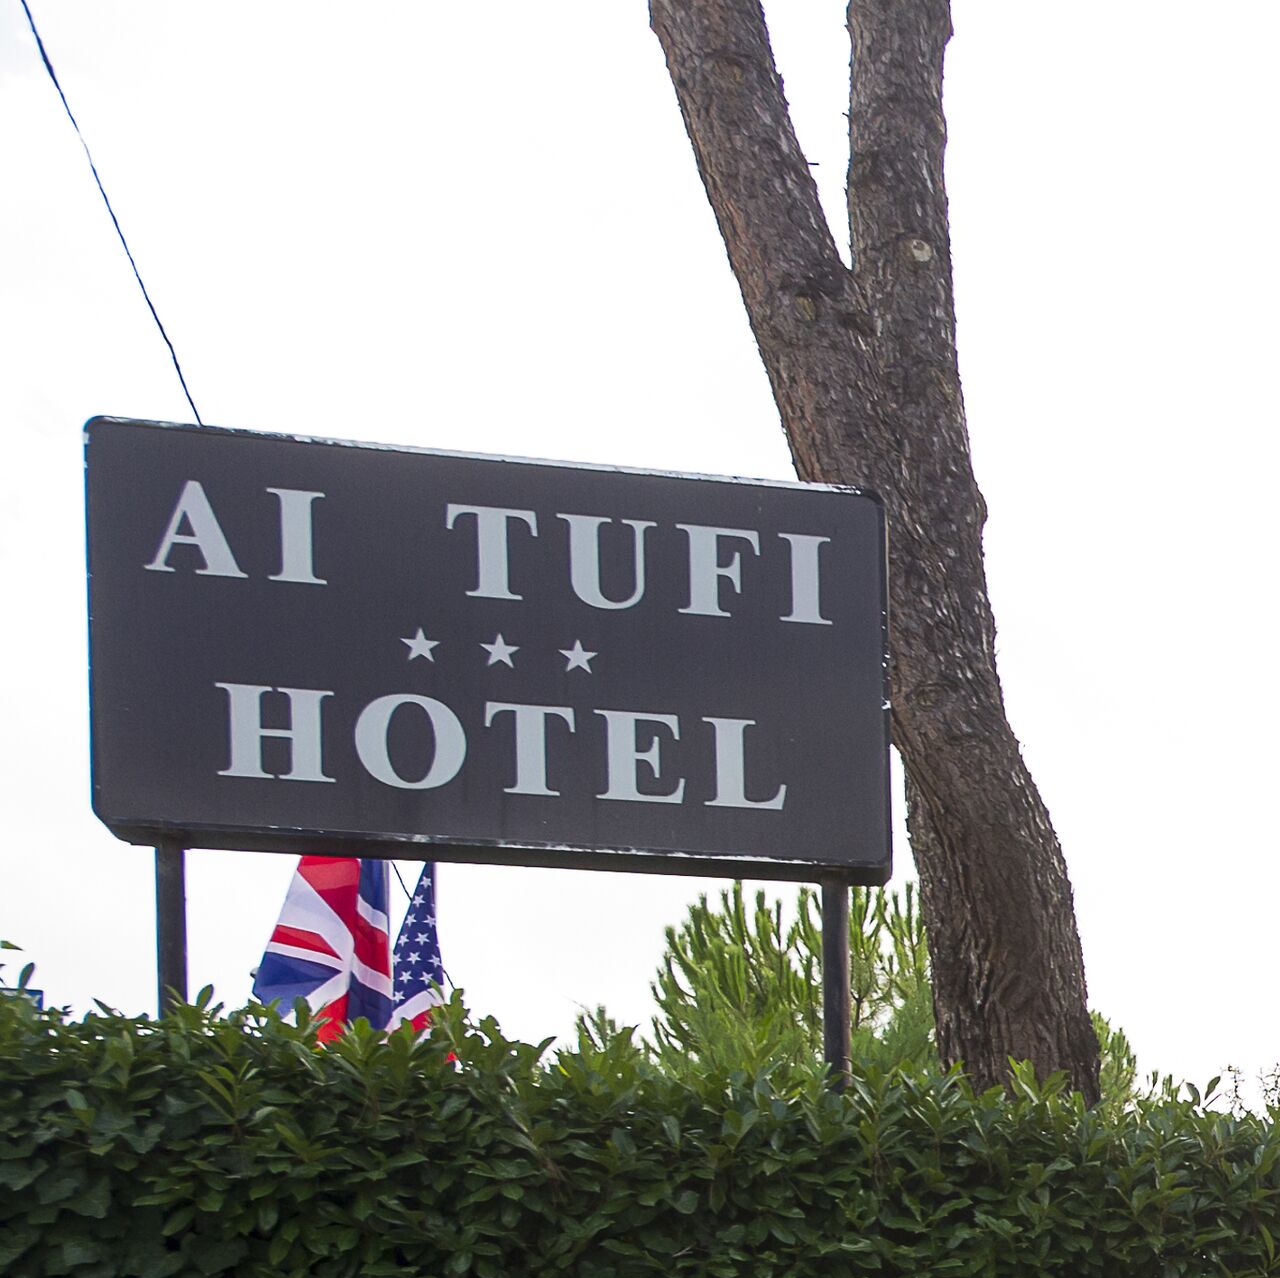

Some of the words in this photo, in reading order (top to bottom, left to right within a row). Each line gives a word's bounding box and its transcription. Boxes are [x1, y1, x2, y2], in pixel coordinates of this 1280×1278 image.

[144, 480, 329, 585] AI
[446, 503, 834, 626] TUFI
[214, 682, 788, 811] HOTEL
